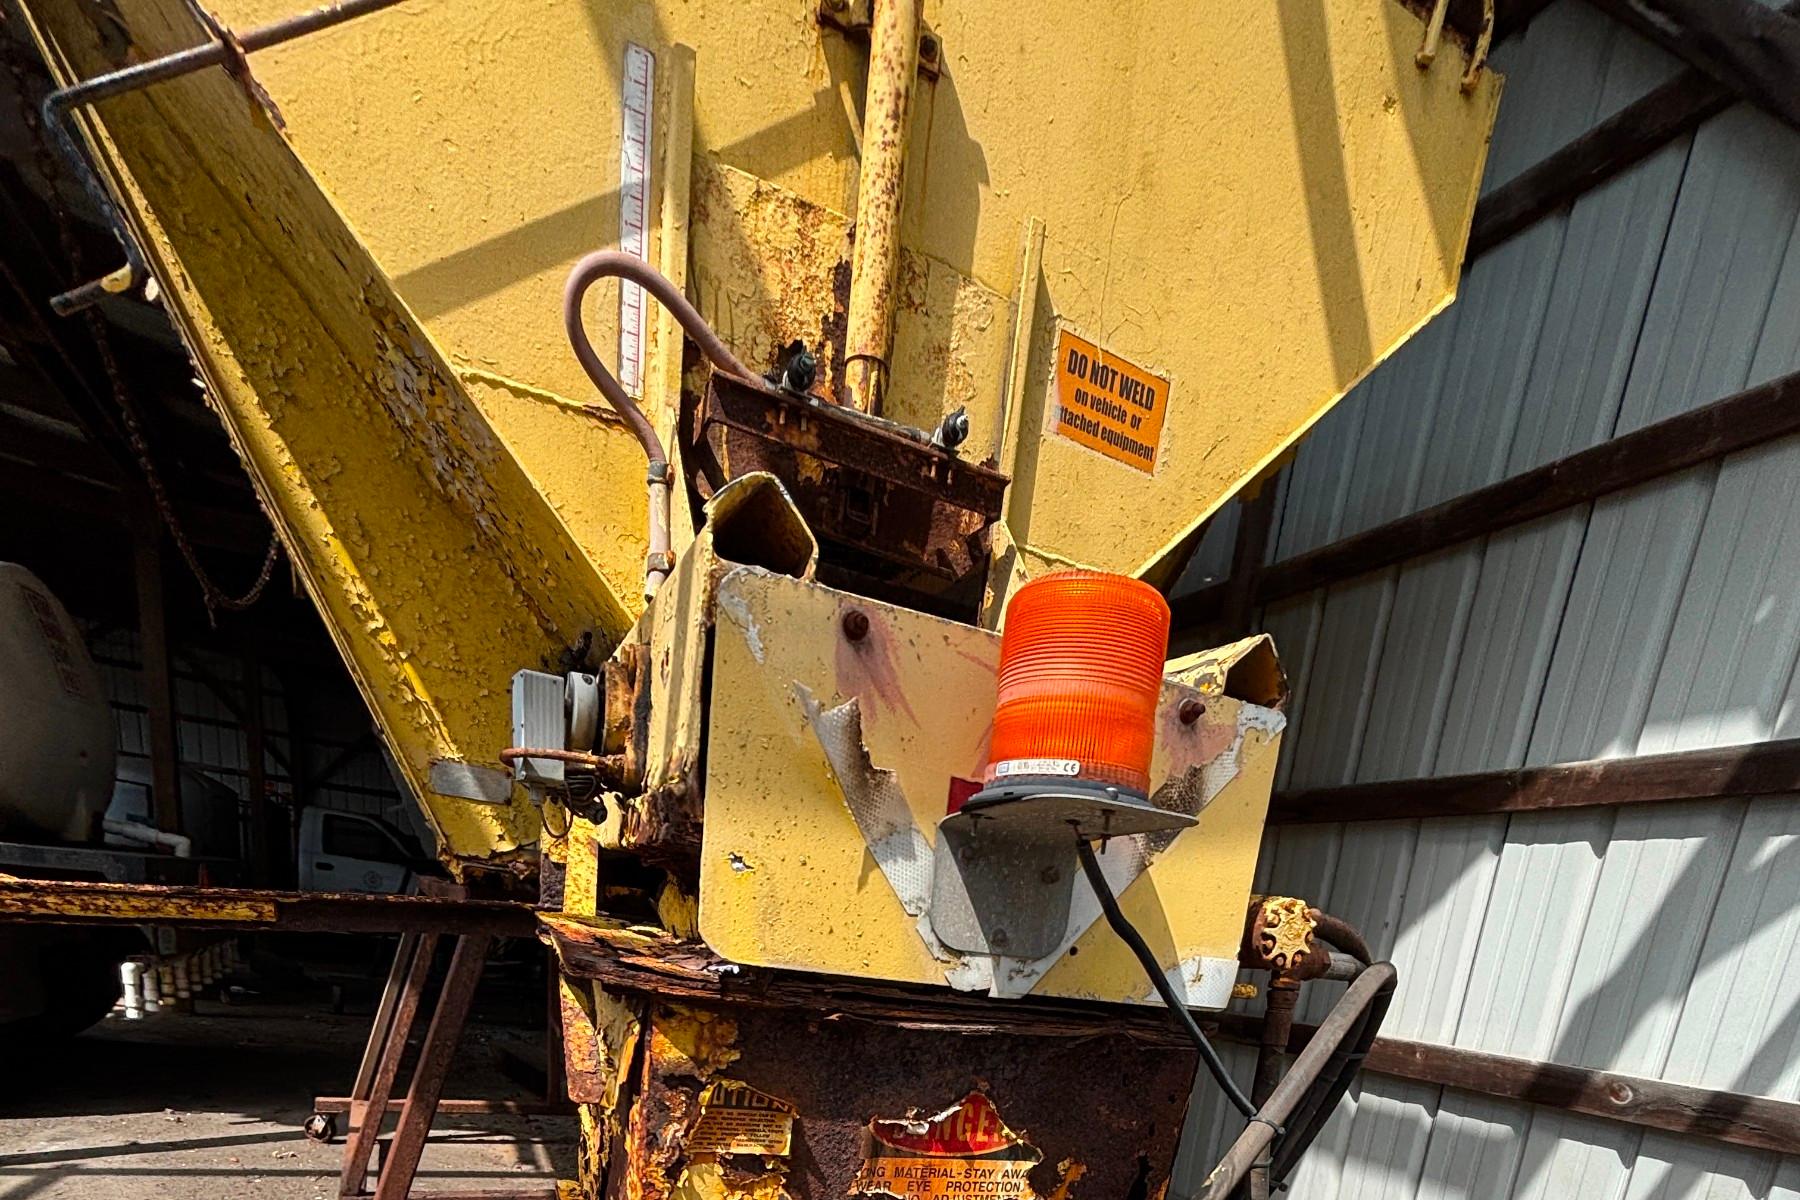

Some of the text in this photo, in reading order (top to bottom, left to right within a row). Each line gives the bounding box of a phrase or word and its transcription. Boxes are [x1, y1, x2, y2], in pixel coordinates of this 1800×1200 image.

[1067, 349, 1156, 411] DO NOT WELD
[1075, 388, 1142, 431] on vehicle or
[1055, 405, 1154, 462] ttached equipment
[894, 1167, 995, 1179] MATERIAL-STAY
[907, 1180, 932, 1192] EYE
